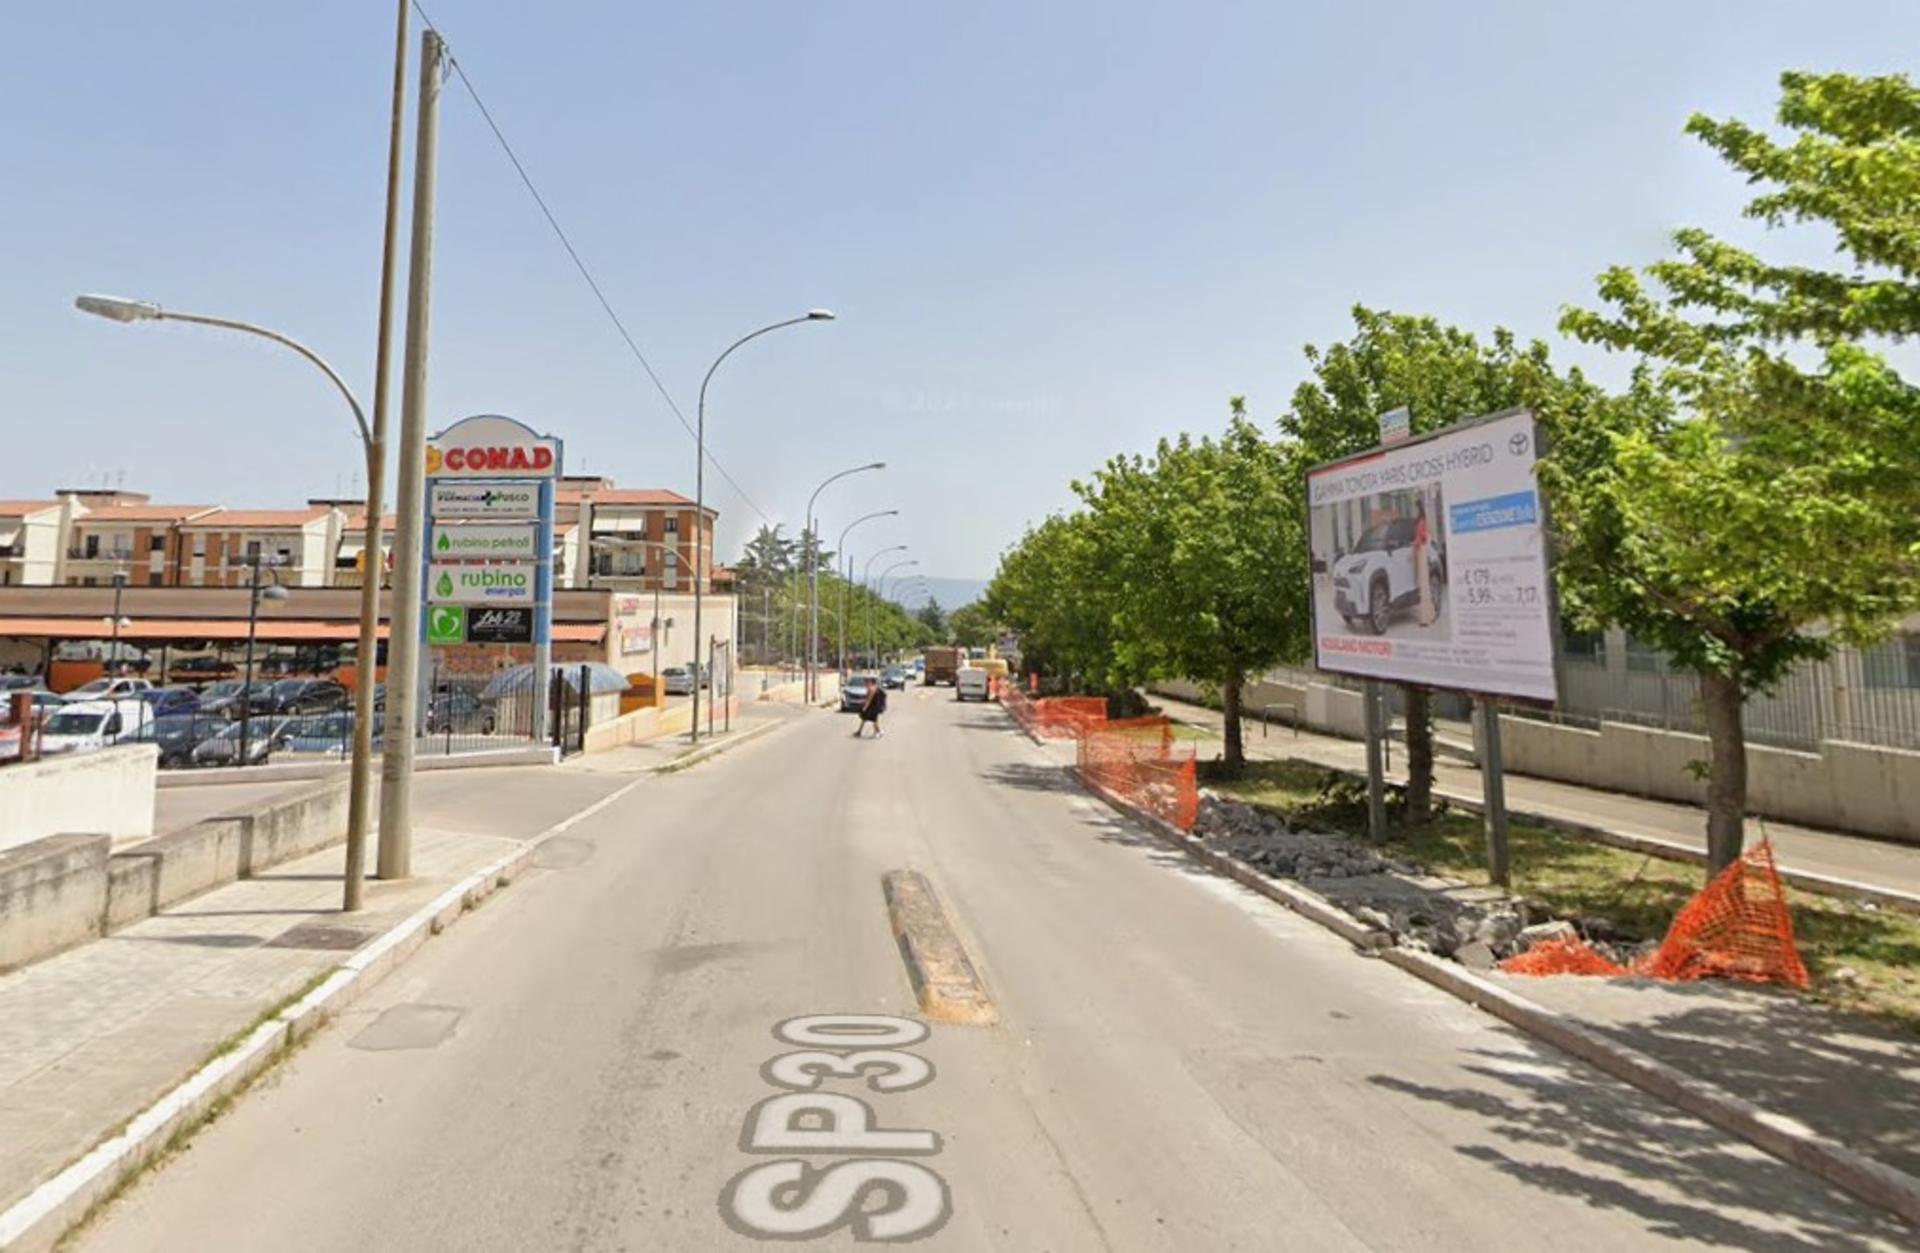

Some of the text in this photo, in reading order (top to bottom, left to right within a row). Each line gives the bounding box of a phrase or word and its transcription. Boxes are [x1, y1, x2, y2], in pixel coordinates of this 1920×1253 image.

[445, 446, 552, 471] CONAD
[1345, 471, 1378, 493] TOYOTA
[1380, 465, 1405, 485] YARIS
[1407, 455, 1444, 482] CROSS
[1446, 443, 1494, 472] HYBRID
[452, 536, 531, 549] rubino petroli
[461, 569, 527, 587] rubino
